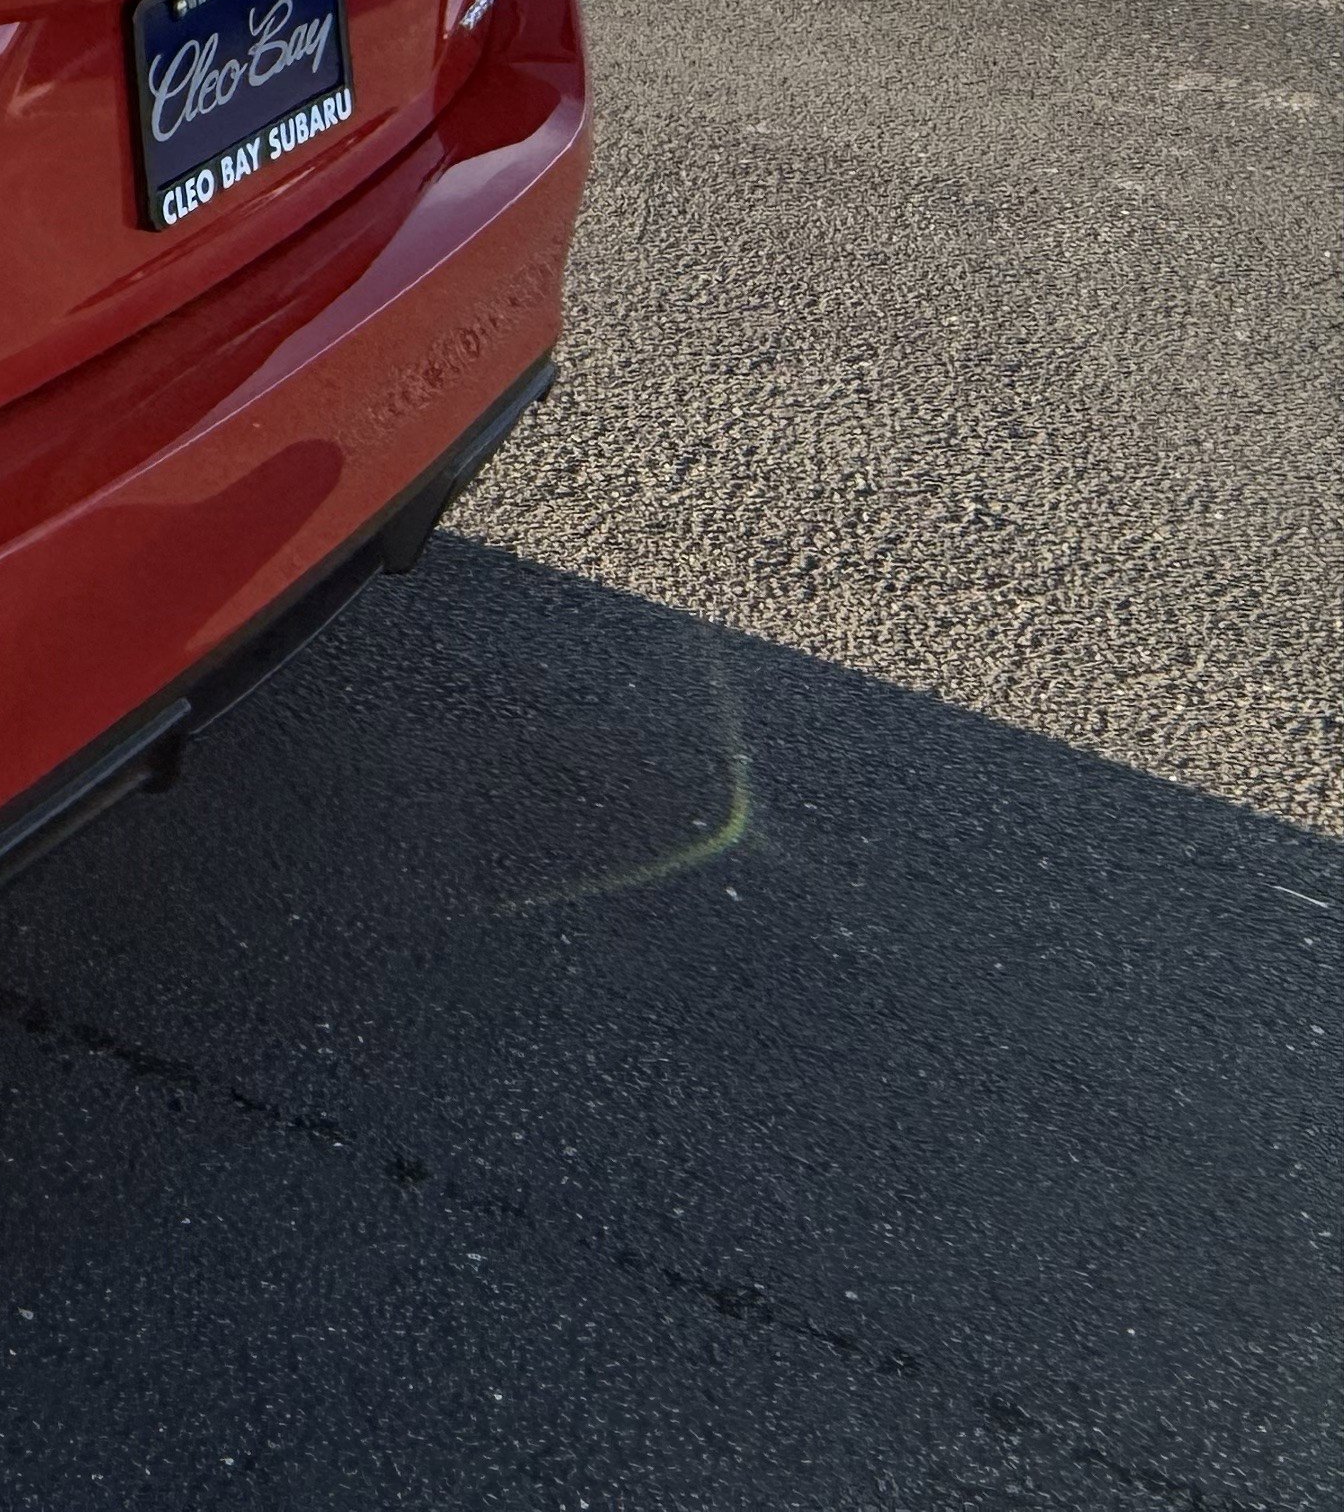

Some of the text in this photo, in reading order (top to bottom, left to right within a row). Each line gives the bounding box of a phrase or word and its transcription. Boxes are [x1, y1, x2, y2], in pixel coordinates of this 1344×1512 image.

[148, 33, 248, 142] Cleo
[162, 88, 353, 226] CLEO BAY SUBARU
